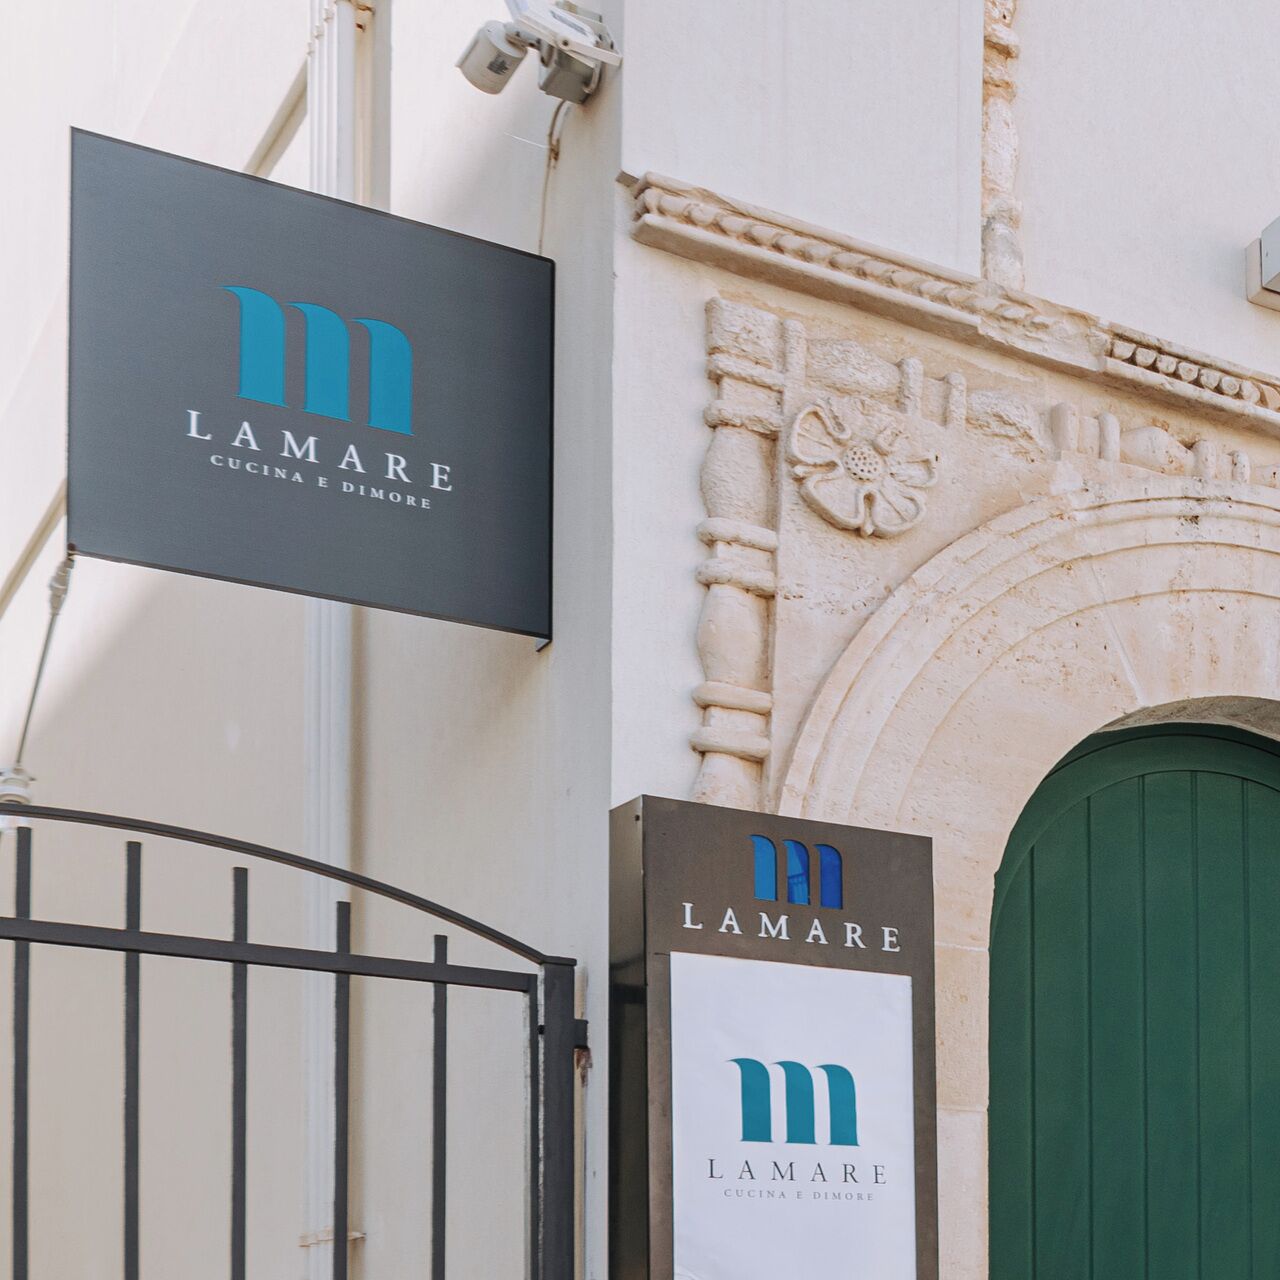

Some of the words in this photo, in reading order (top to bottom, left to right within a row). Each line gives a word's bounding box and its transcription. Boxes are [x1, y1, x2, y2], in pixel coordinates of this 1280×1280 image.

[186, 409, 454, 492] LAMARE
[210, 453, 304, 483] CUCINA
[317, 476, 329, 488] E
[341, 480, 432, 509] DIMORE
[682, 902, 901, 952] LAMARE
[708, 1158, 887, 1185] LAMARE
[723, 1188, 787, 1199] CUCINA
[796, 1190, 803, 1200] E
[812, 1191, 875, 1201] DIMORE
